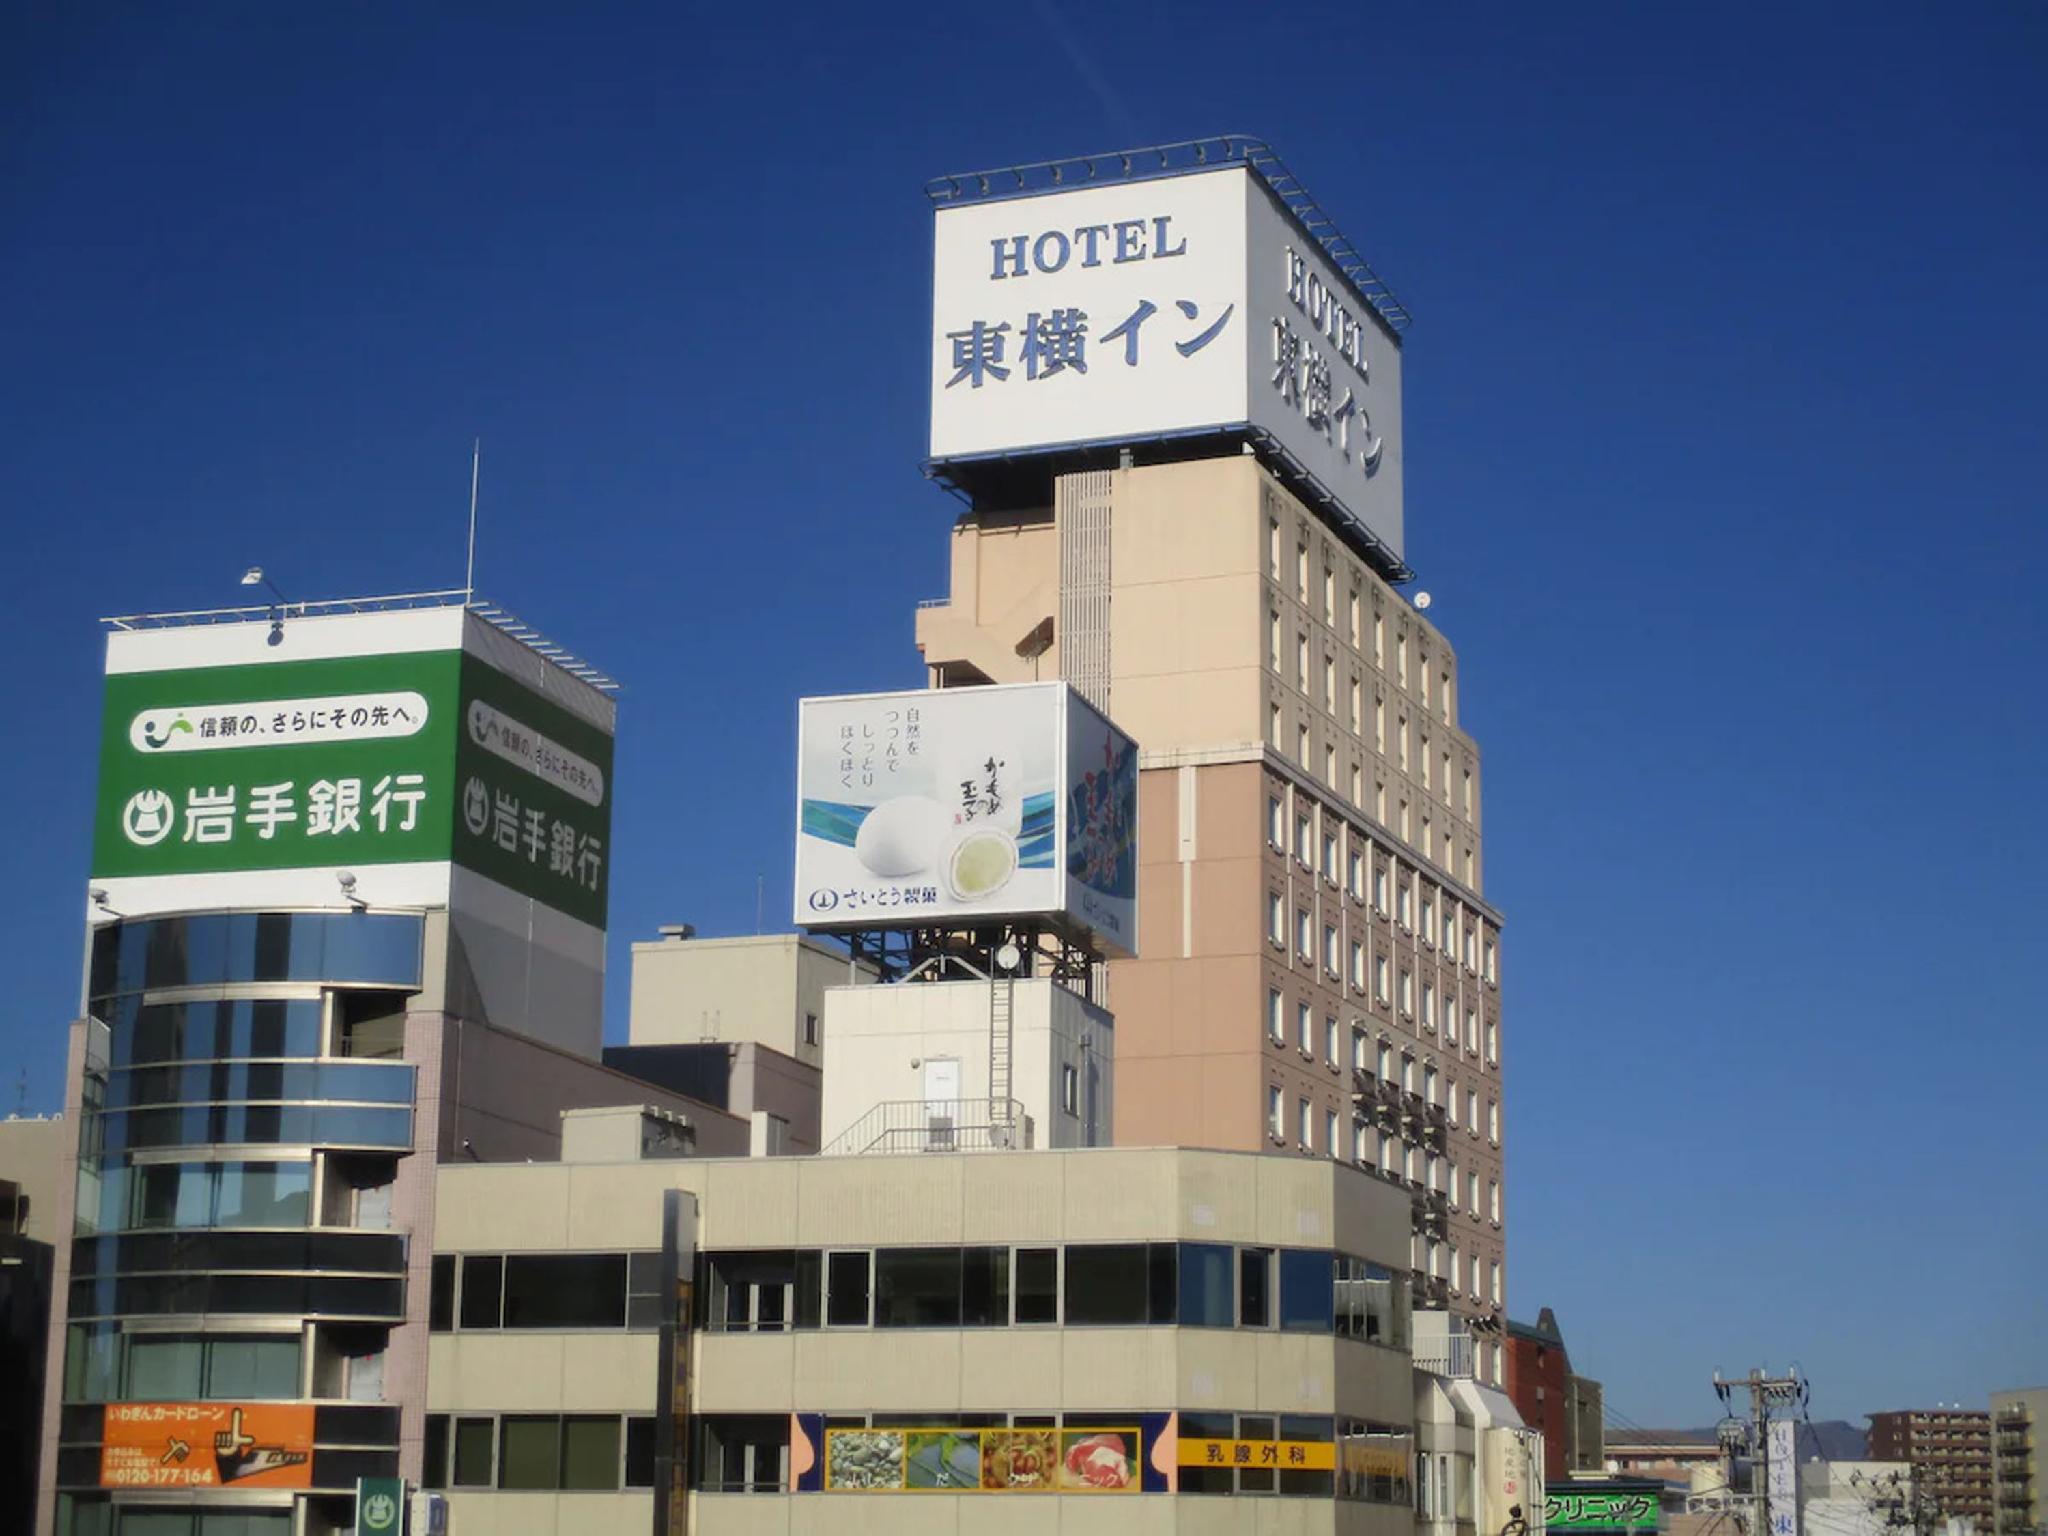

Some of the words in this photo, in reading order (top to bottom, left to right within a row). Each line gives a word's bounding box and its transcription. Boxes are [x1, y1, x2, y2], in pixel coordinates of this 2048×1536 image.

[990, 215, 1187, 280] HOTEL
[1286, 245, 1369, 375] HOTEL
[944, 299, 1235, 389] 東横イン
[1271, 316, 1383, 470] 東横イン
[200, 706, 418, 738] 信頼の、さらにその先へ。
[884, 710, 899, 772] つつんで
[906, 707, 920, 755] 自然を
[183, 774, 426, 843] 岩手銀行
[492, 787, 602, 892] 岩手銀行
[844, 886, 937, 909] さいとう製菓
[108, 1406, 225, 1421] いわぎんカードローン
[116, 1467, 213, 1484] 0120-177-164
[1207, 1444, 1306, 1464] 乳腺外科
[1546, 1497, 1652, 1521] クリニック
